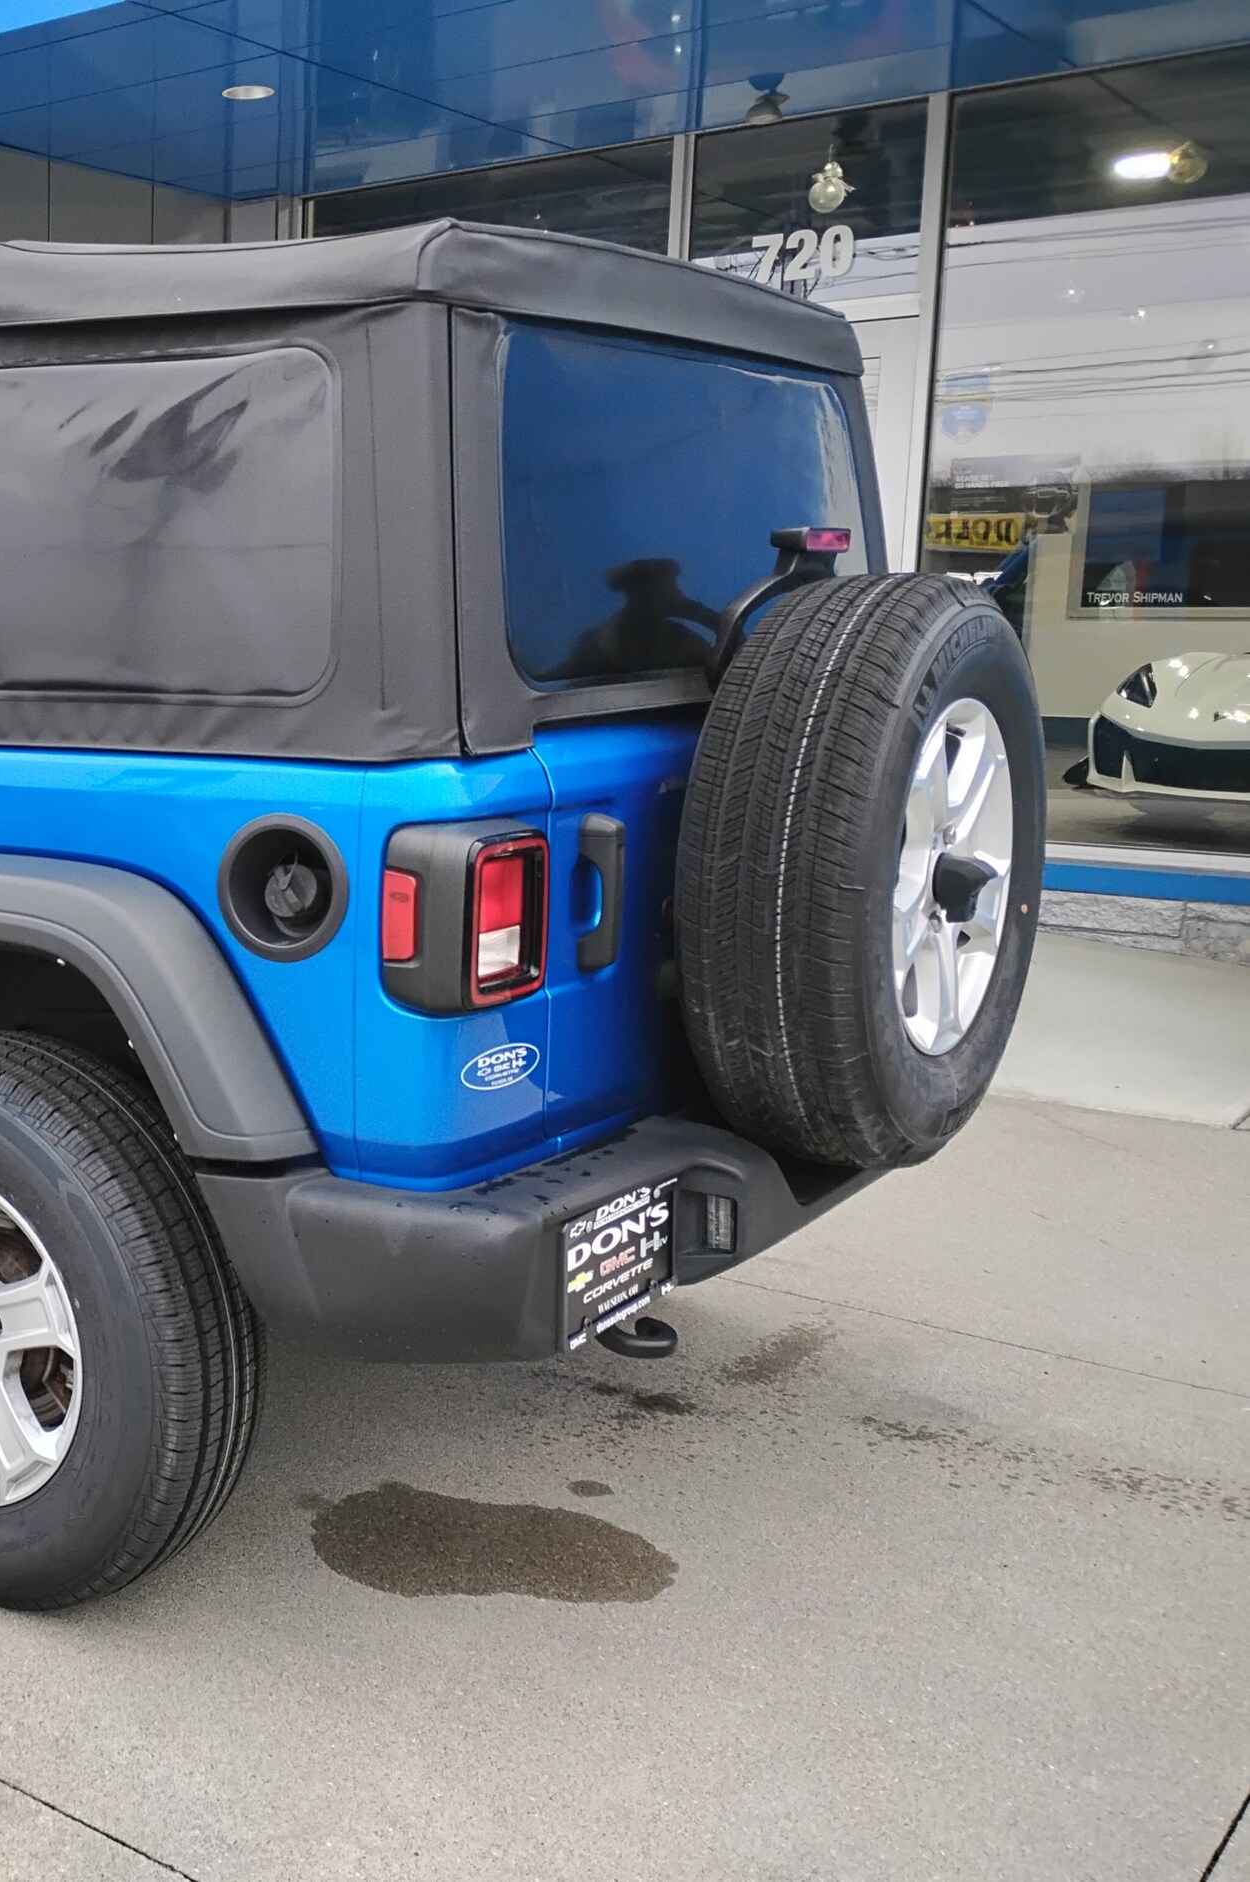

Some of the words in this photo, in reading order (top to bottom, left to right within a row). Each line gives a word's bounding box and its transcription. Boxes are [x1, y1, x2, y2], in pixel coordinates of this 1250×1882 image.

[752, 225, 854, 284] 720
[1086, 591, 1130, 603] TREVOR
[1133, 591, 1183, 603] SHIPMAN
[477, 1047, 527, 1068] DON'S
[595, 1187, 651, 1221] DON'S
[567, 1201, 669, 1272] DON'S
[600, 1246, 636, 1277] GMC
[583, 1257, 653, 1304] CORVETTE
[596, 1296, 651, 1333] donsautogroup.com
